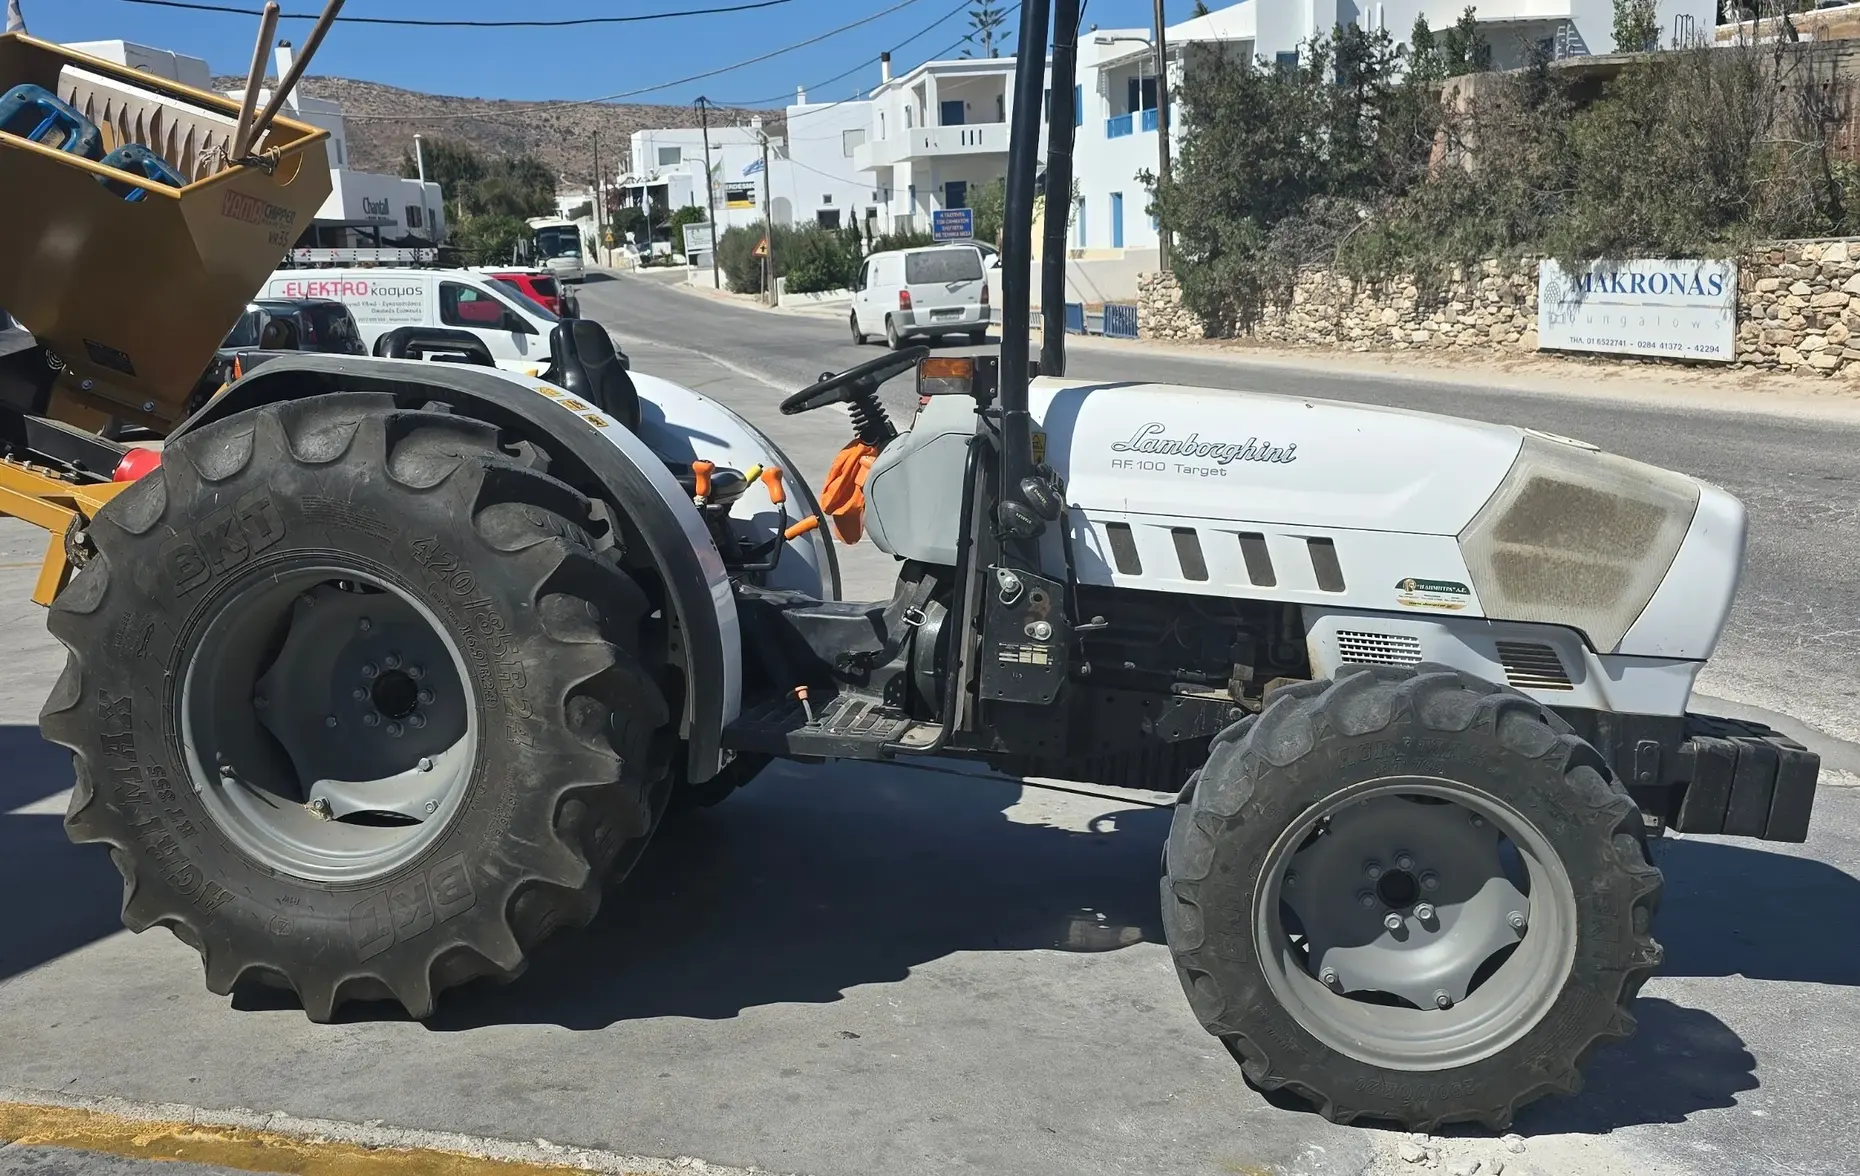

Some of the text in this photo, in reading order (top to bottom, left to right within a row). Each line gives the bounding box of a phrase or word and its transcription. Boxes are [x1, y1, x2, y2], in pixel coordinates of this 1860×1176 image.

[223, 190, 262, 224] YAMA
[285, 281, 368, 297] ELEKTRO
[1571, 272, 1724, 297] MAKRONAS
[1637, 340, 1656, 349] 0284
[1659, 342, 1683, 351] 41372
[1694, 344, 1720, 353] 42294
[1110, 421, 1297, 465] Lamborghini
[1173, 463, 1227, 477] Target
[159, 482, 286, 595] BKT
[349, 850, 475, 962] BKT
